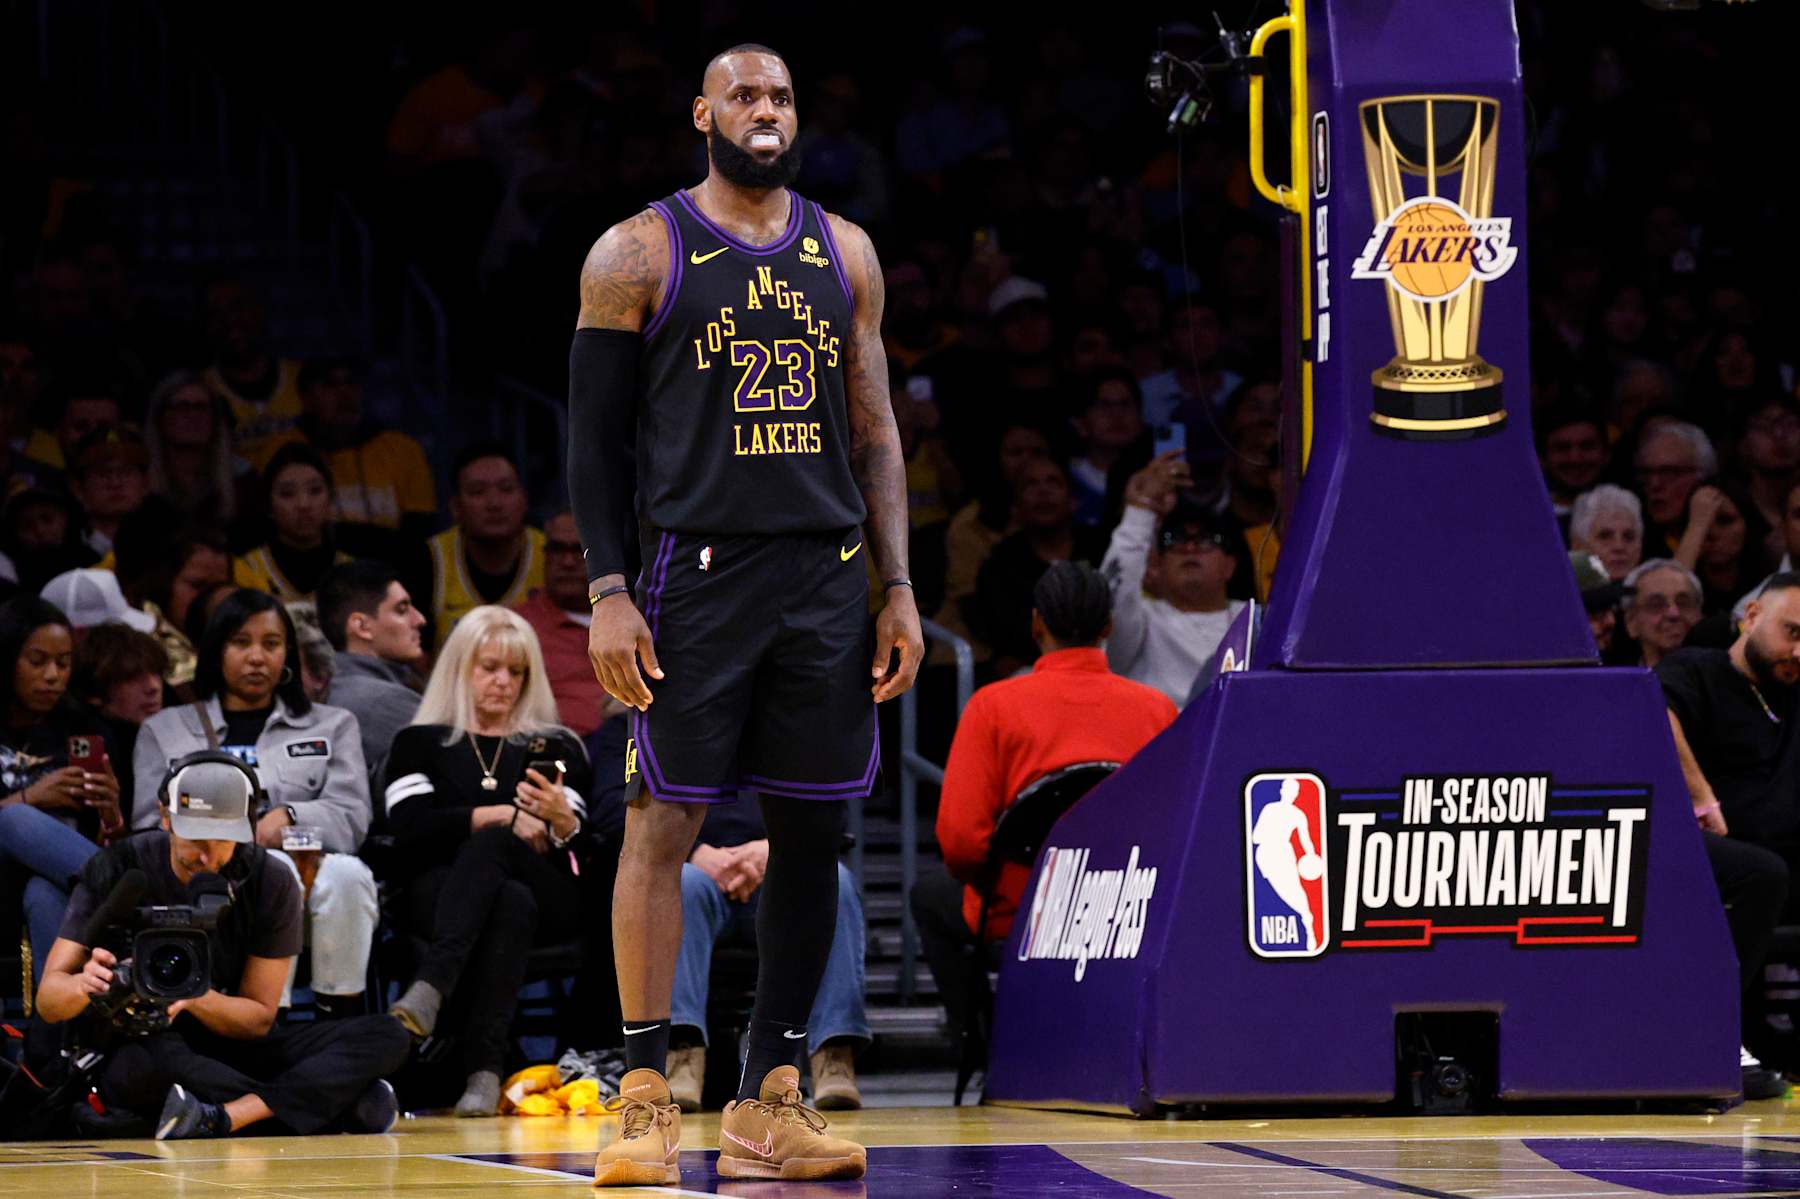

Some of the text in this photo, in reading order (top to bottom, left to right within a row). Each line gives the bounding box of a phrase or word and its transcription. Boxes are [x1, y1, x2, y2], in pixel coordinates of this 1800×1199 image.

[1368, 225, 1504, 274] LAKERS
[1407, 223, 1504, 233] LOS ANGELES
[798, 252, 829, 268] bibigo
[694, 266, 840, 370] LOS ANGELES
[730, 338, 817, 413] 23
[734, 422, 822, 456] LAKERS
[1402, 776, 1548, 826] IN-SEASON
[1337, 807, 1647, 932] TOURNAMENT
[1104, 845, 1158, 959] Pass
[1260, 915, 1300, 945] NBA
